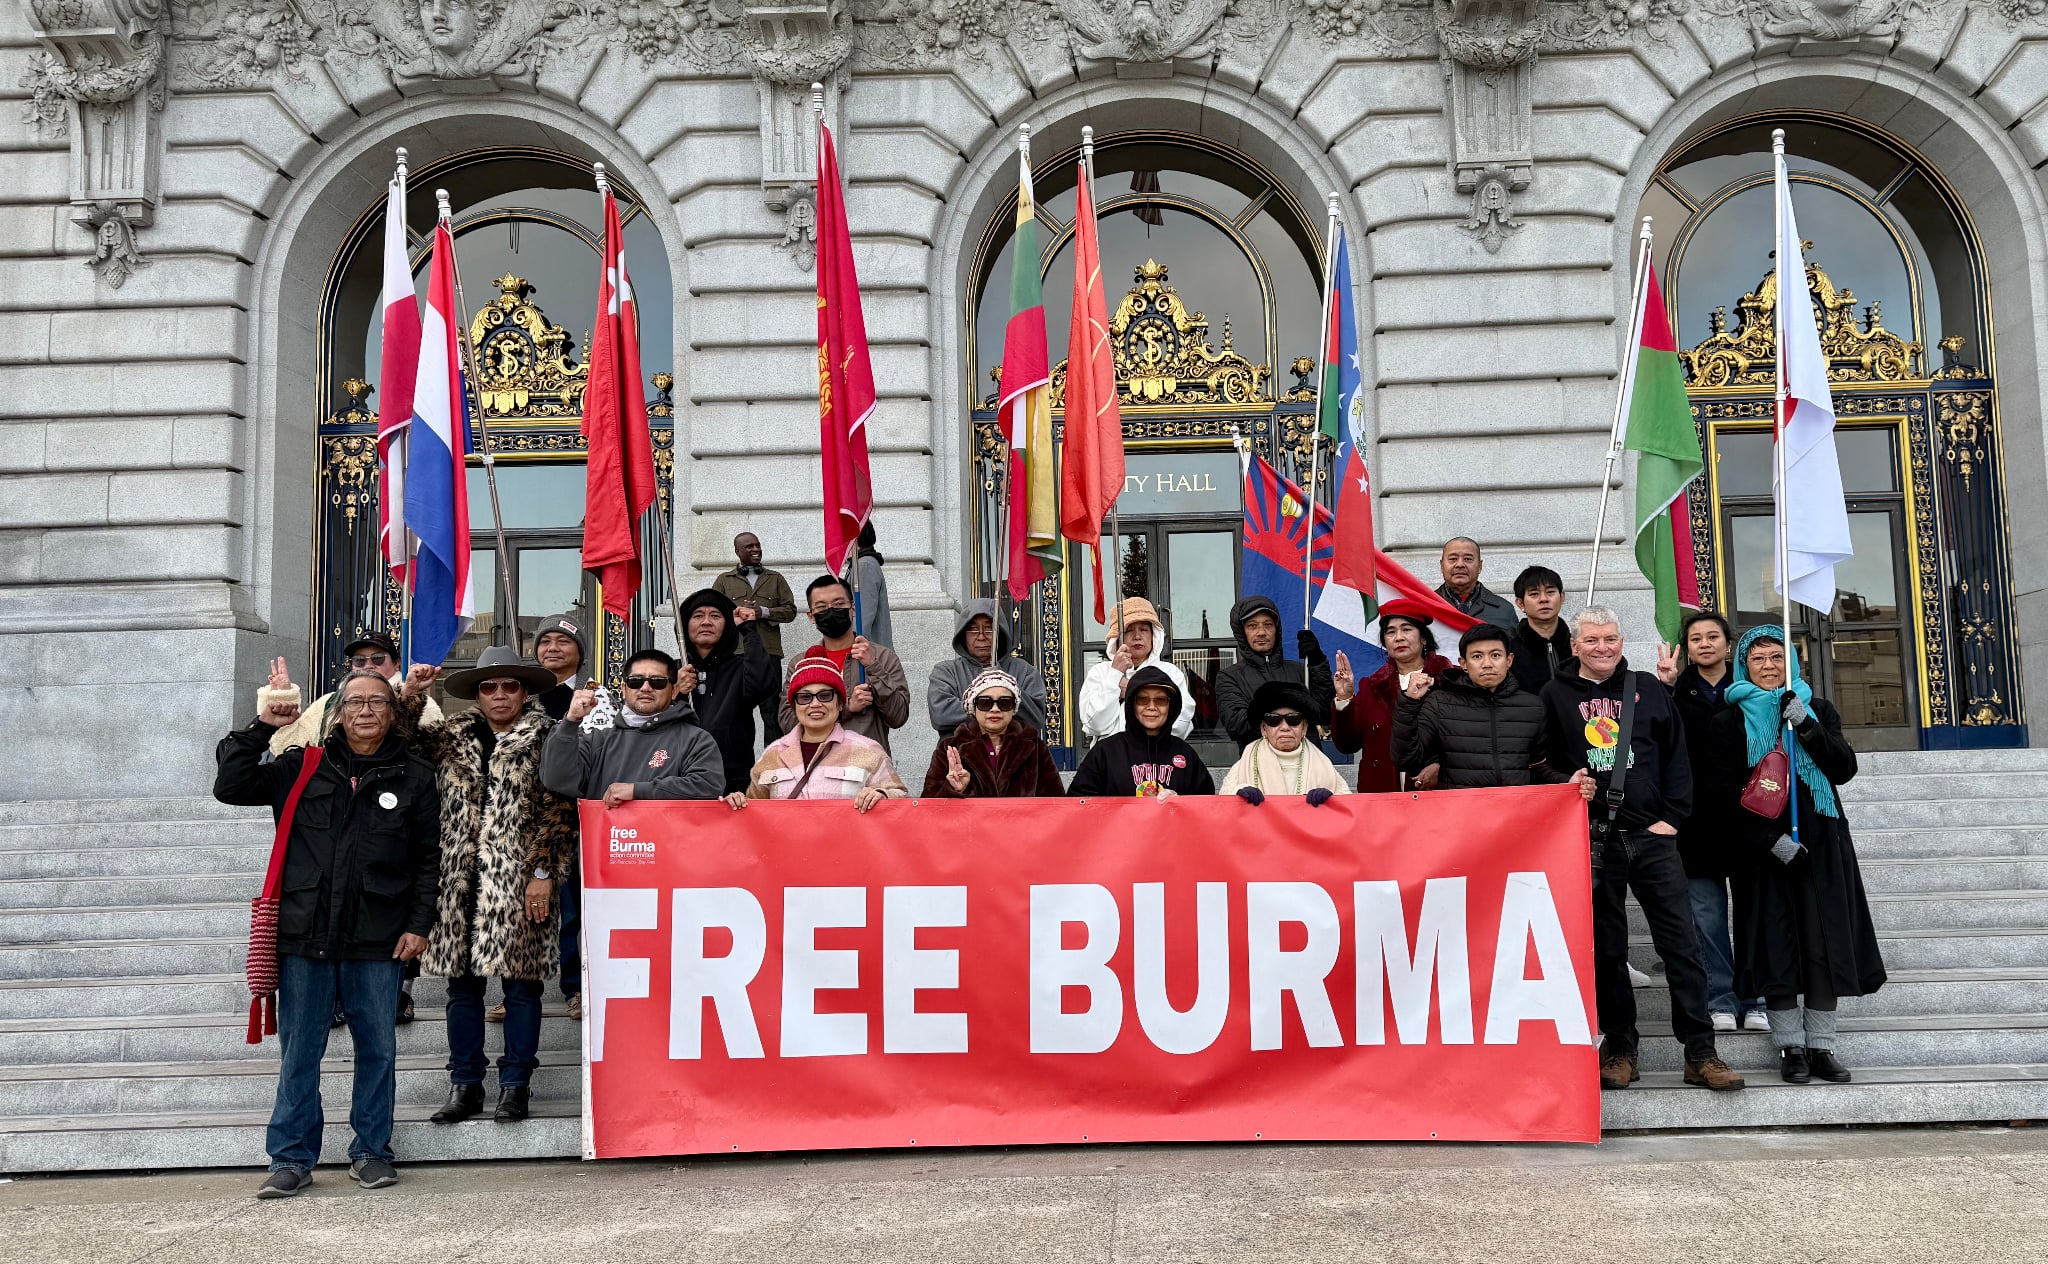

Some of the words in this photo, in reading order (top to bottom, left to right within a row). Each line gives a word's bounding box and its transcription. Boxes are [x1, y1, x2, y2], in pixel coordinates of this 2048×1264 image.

[1123, 475, 1149, 493] TY
[1156, 473, 1217, 492] HALL
[610, 826, 637, 839] free
[610, 839, 655, 852] Burma
[584, 885, 969, 1062] FREE
[1029, 871, 1593, 1054] BURMA
